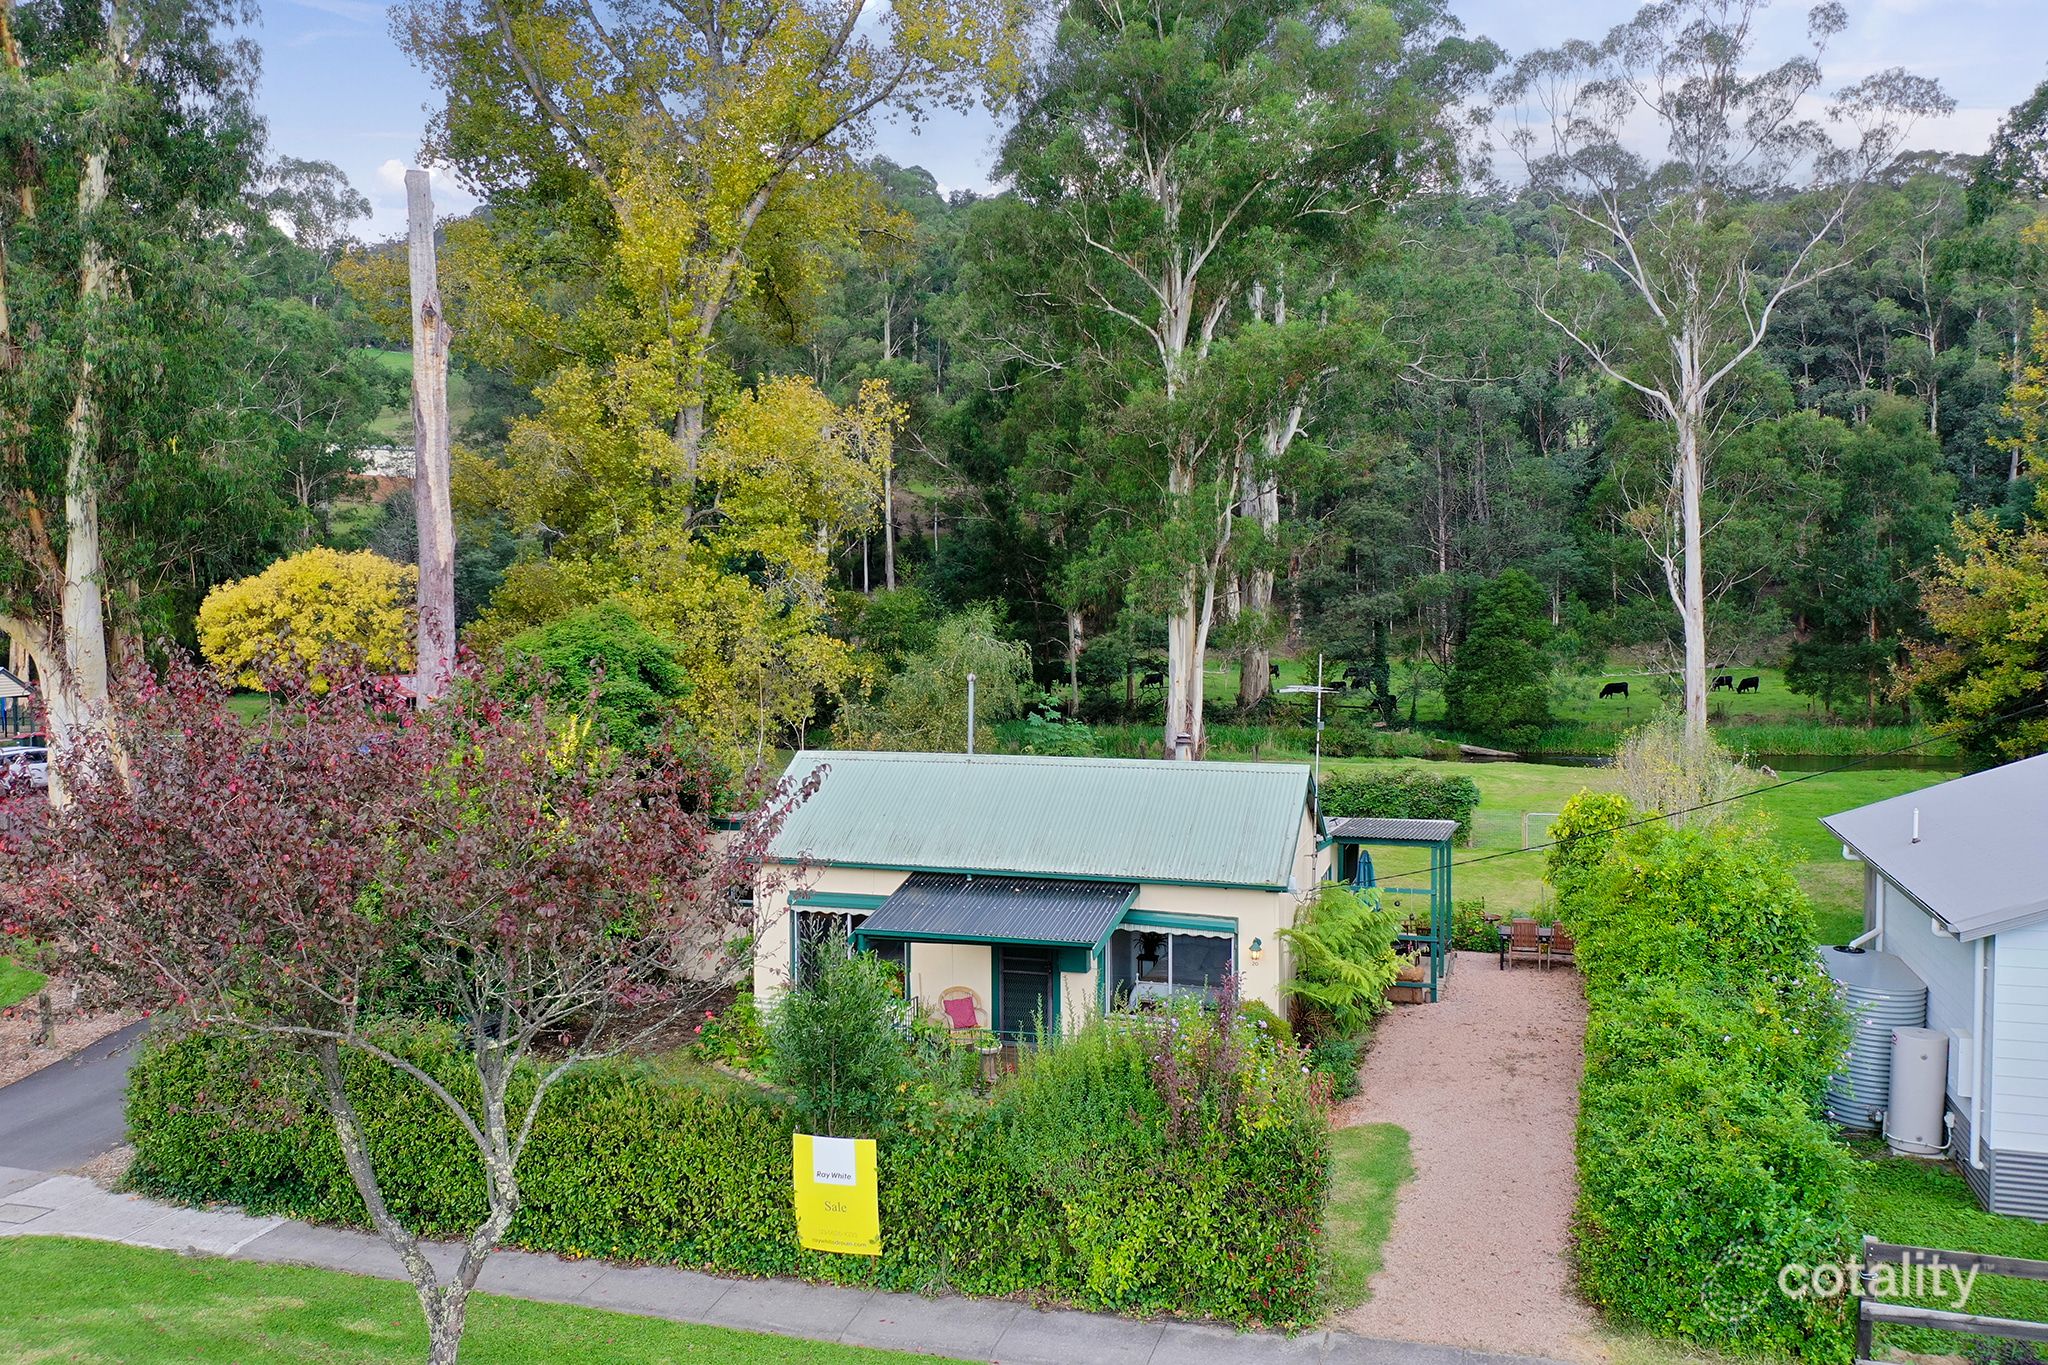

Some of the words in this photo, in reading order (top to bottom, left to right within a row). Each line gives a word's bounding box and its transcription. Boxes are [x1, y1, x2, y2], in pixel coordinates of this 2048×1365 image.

[816, 1170, 830, 1179] Ray
[831, 1172, 852, 1180] White
[824, 1201, 847, 1212] Sale
